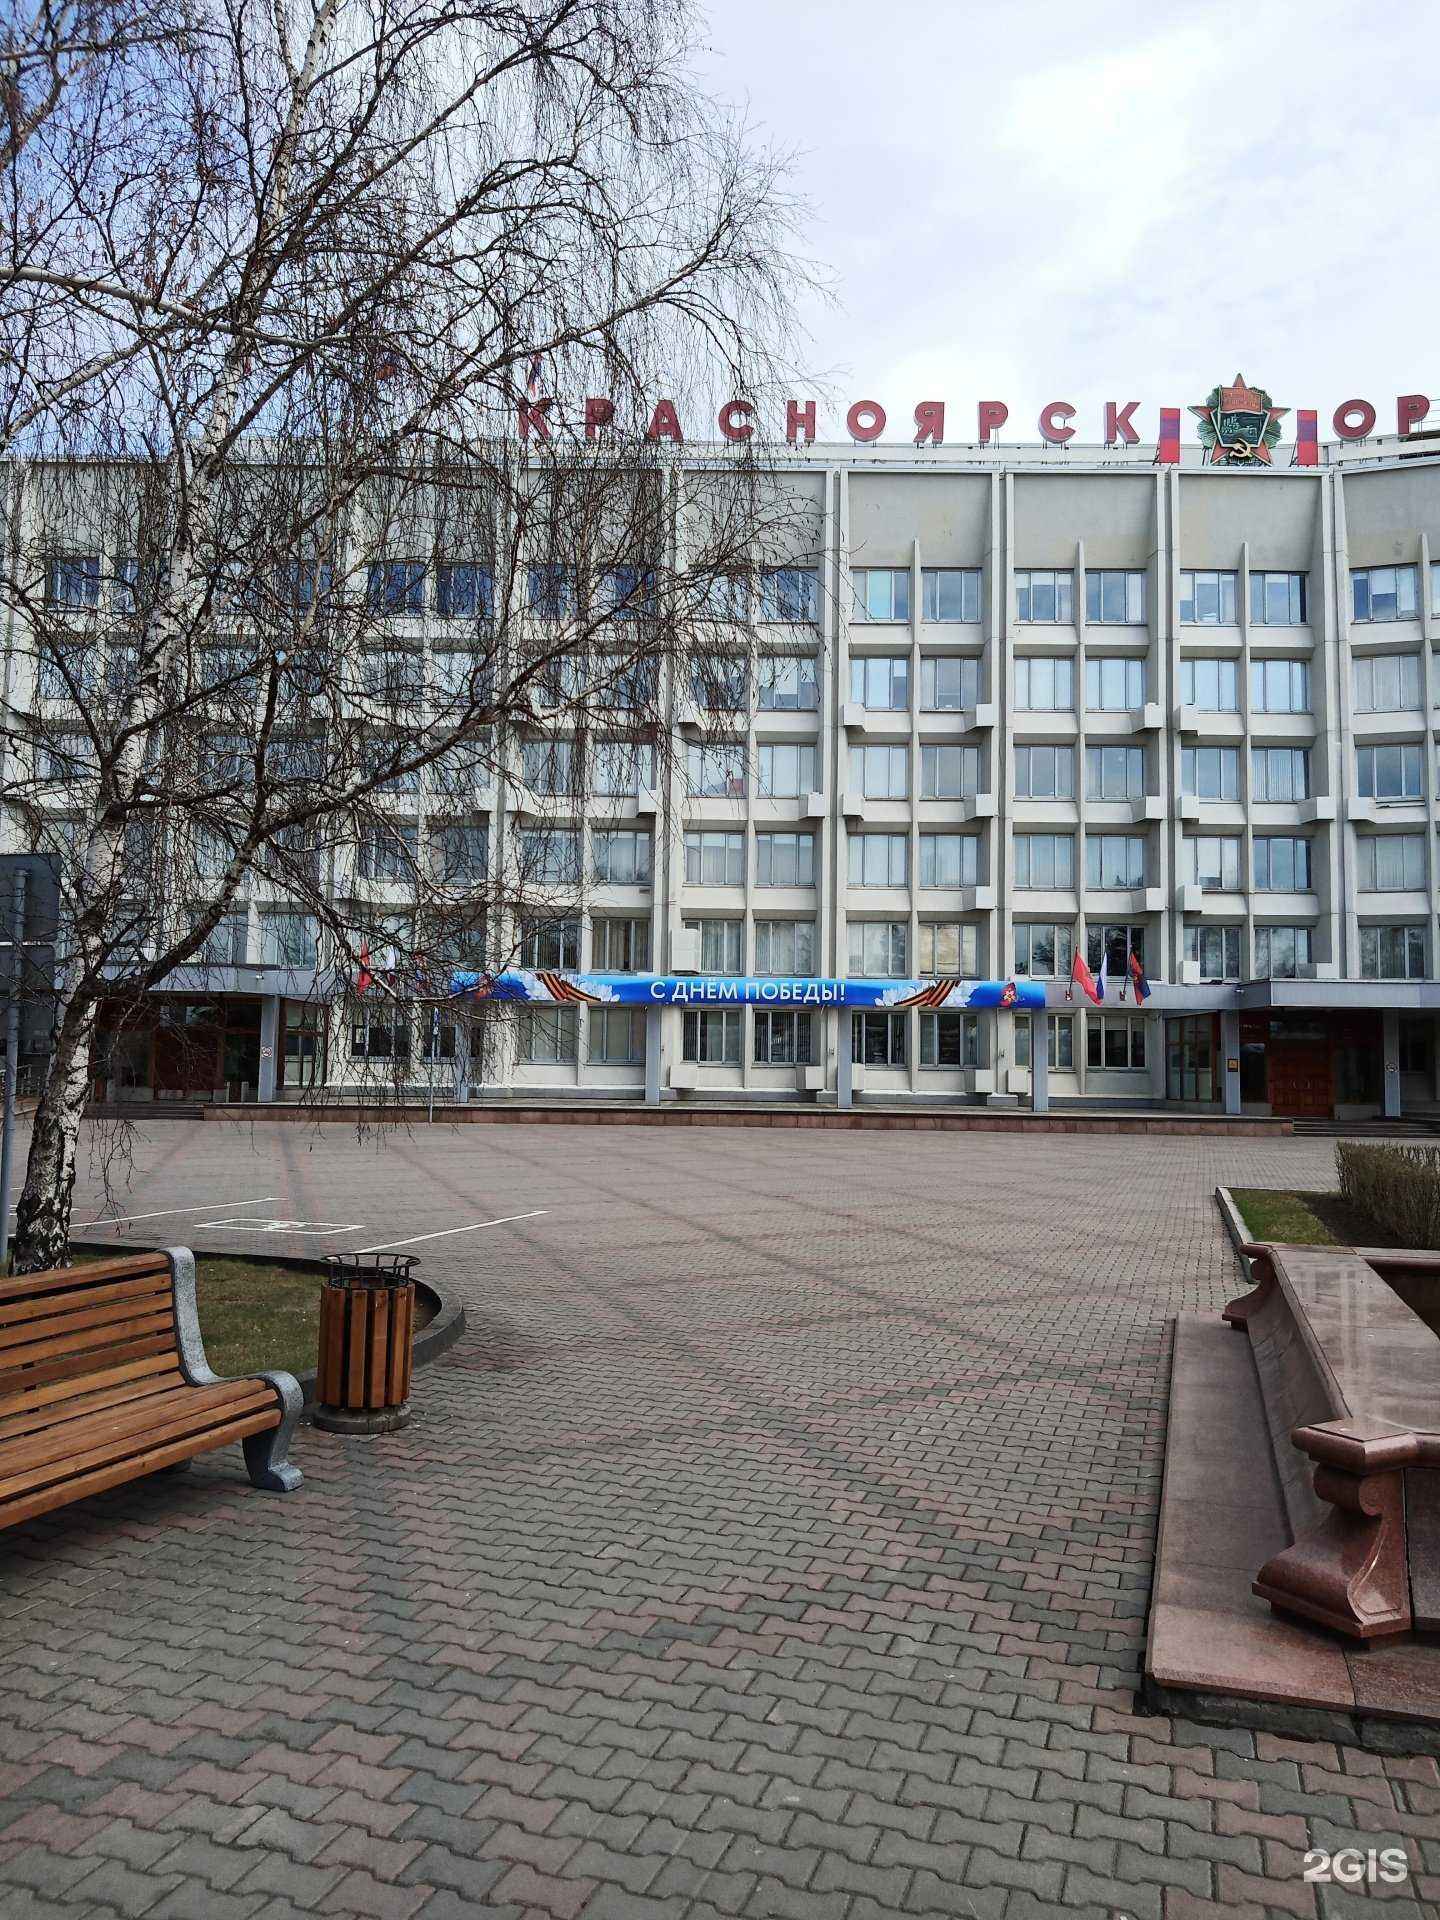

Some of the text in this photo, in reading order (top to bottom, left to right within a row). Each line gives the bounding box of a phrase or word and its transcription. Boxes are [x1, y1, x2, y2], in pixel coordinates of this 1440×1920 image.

[518, 398, 1141, 444] КРАСНОЯРСК
[650, 978, 846, 1004] С ДНЁМ ПОБЕДЫ!
